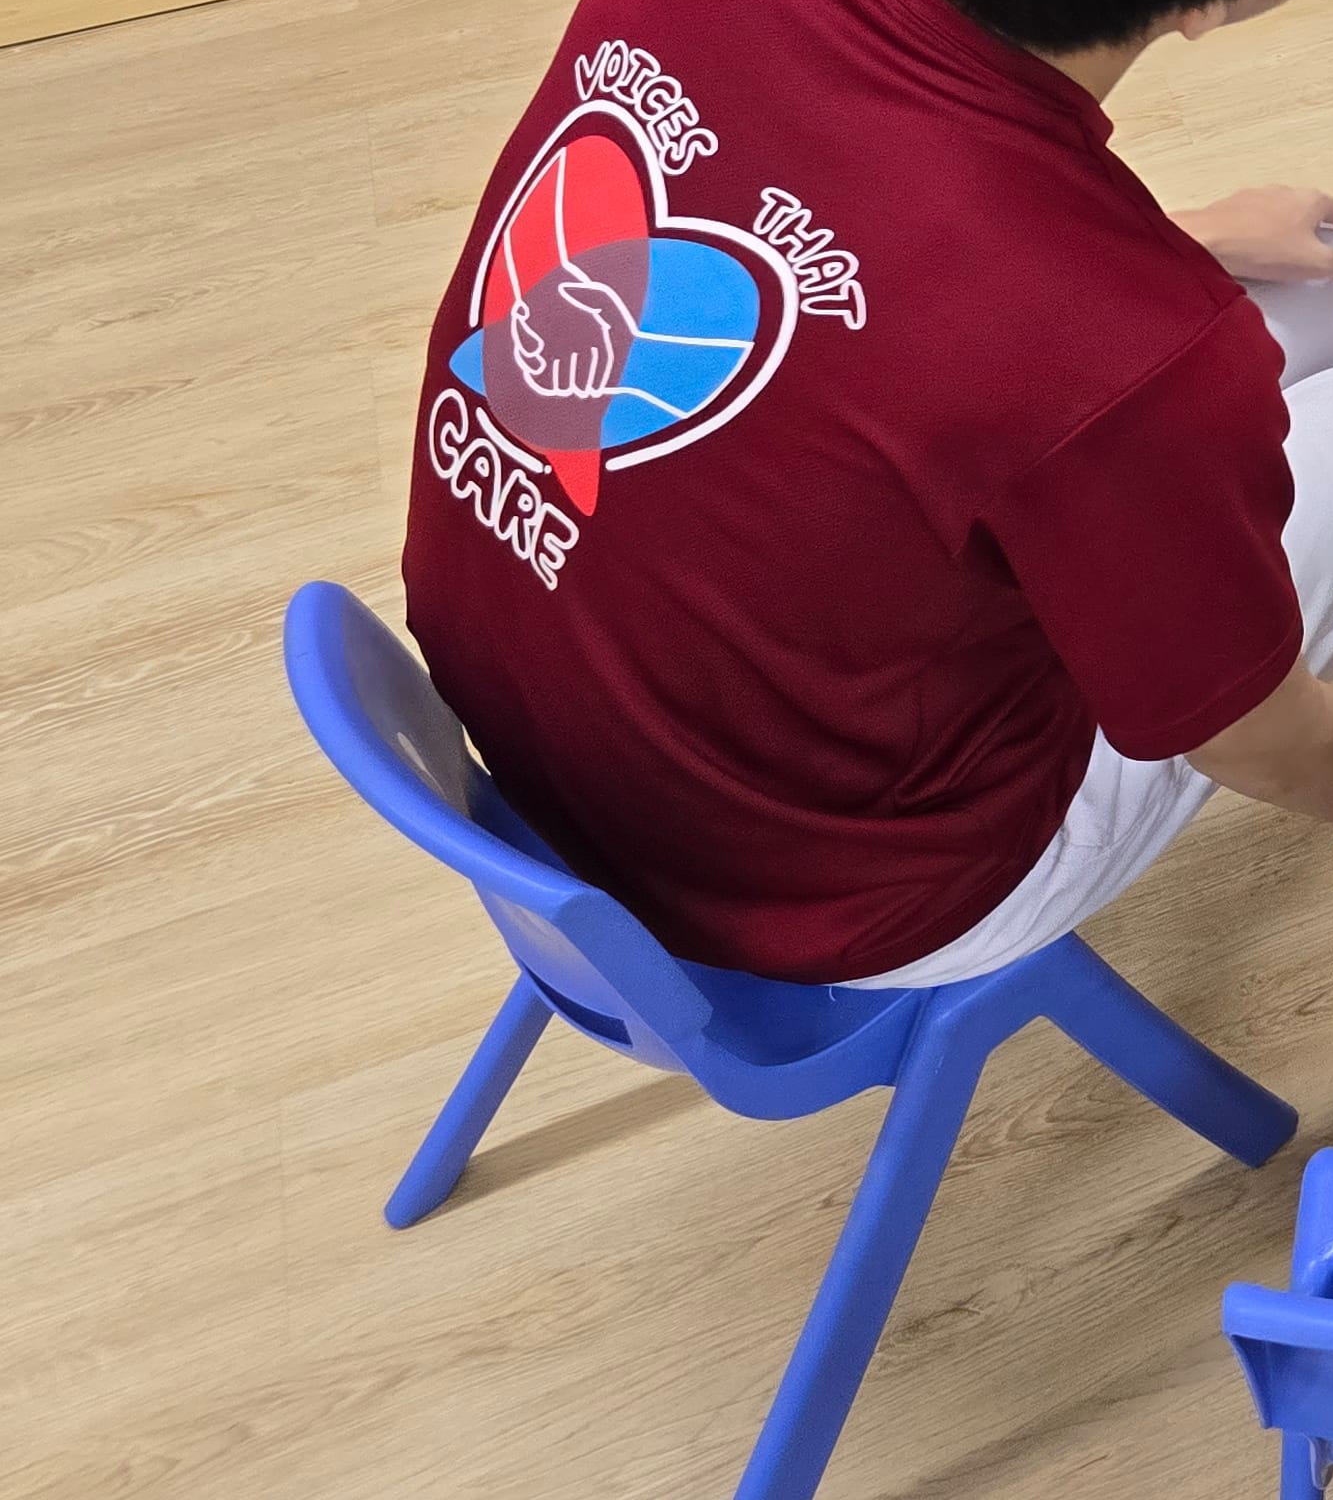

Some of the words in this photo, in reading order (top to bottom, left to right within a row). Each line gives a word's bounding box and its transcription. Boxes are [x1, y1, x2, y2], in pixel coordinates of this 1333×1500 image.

[575, 40, 718, 176] VOICES
[754, 187, 867, 330] THAT
[429, 388, 580, 591] CARE
